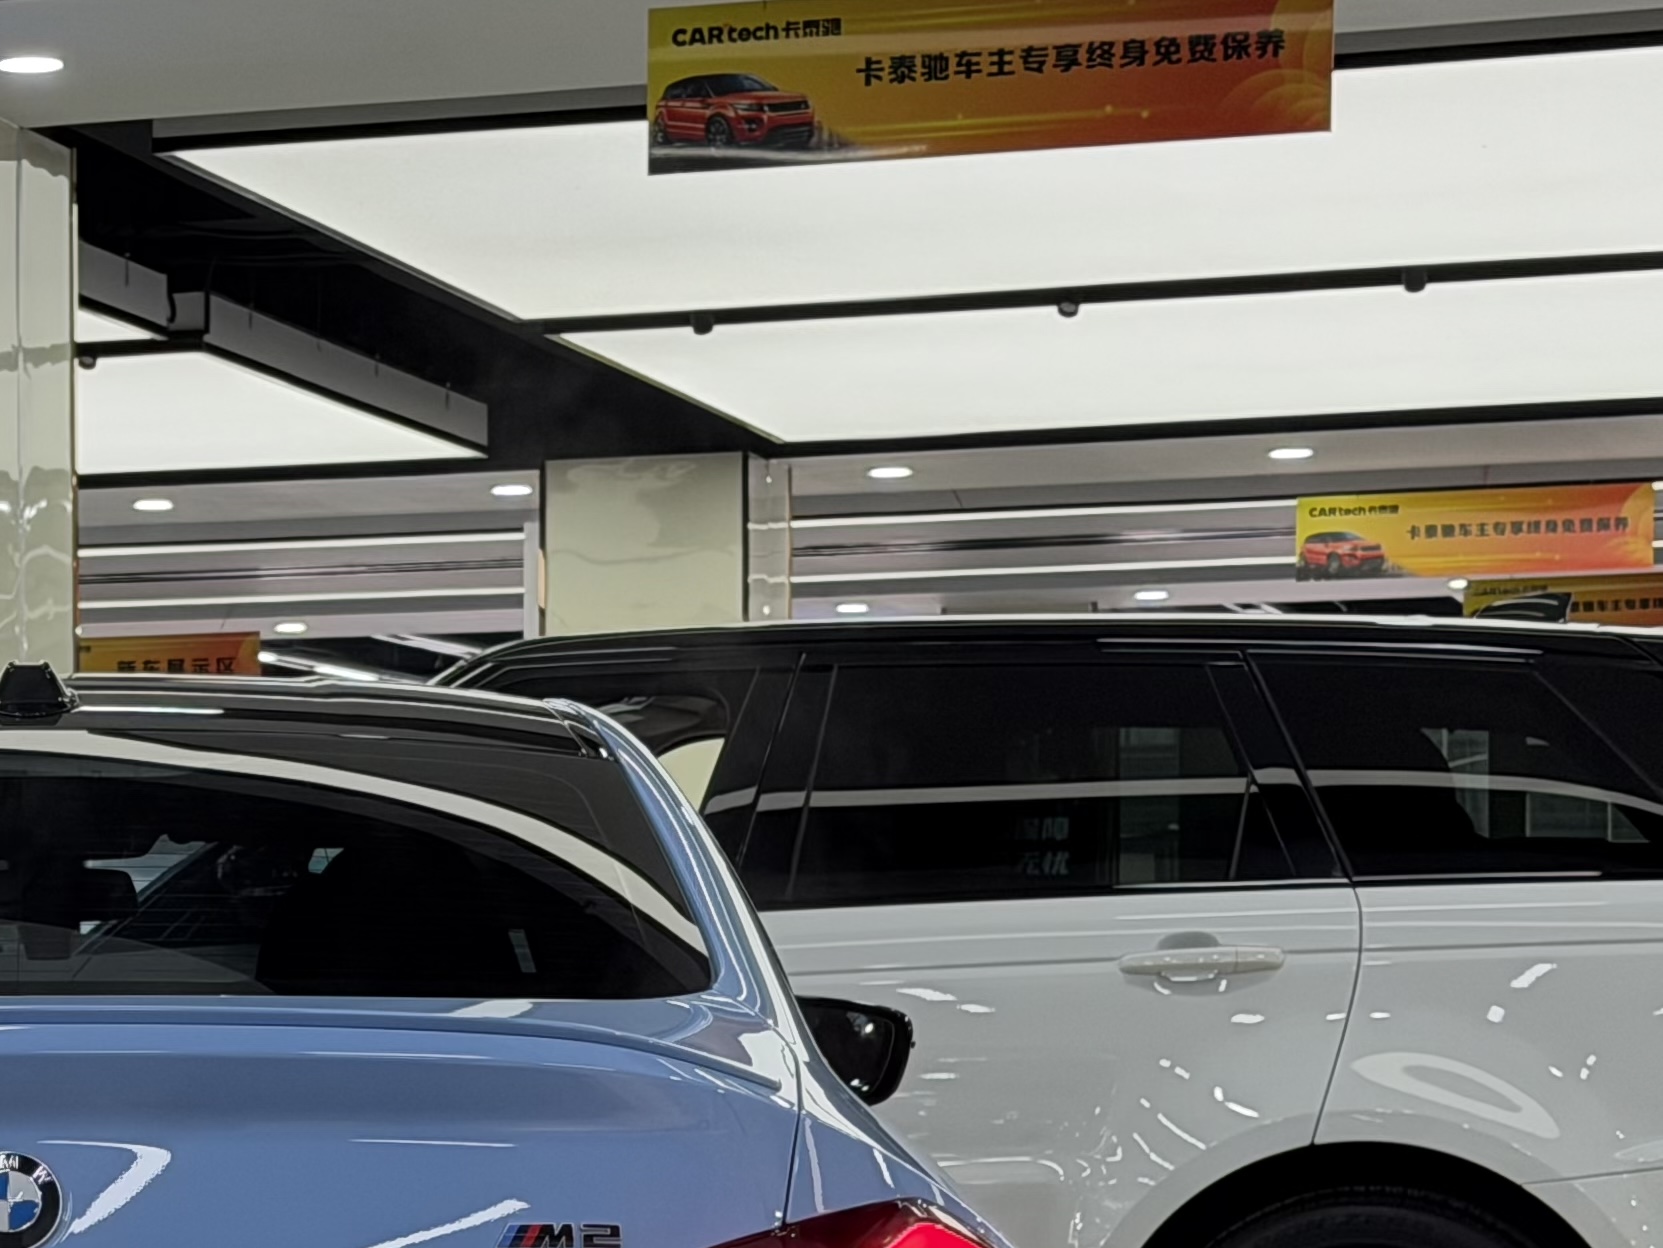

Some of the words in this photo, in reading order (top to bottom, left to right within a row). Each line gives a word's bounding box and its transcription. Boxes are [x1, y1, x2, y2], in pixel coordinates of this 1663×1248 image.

[672, 22, 779, 47] CARtech
[782, 17, 842, 39] 卡泰驰
[855, 28, 1286, 87] 卡泰驰车主专享终身免费保养
